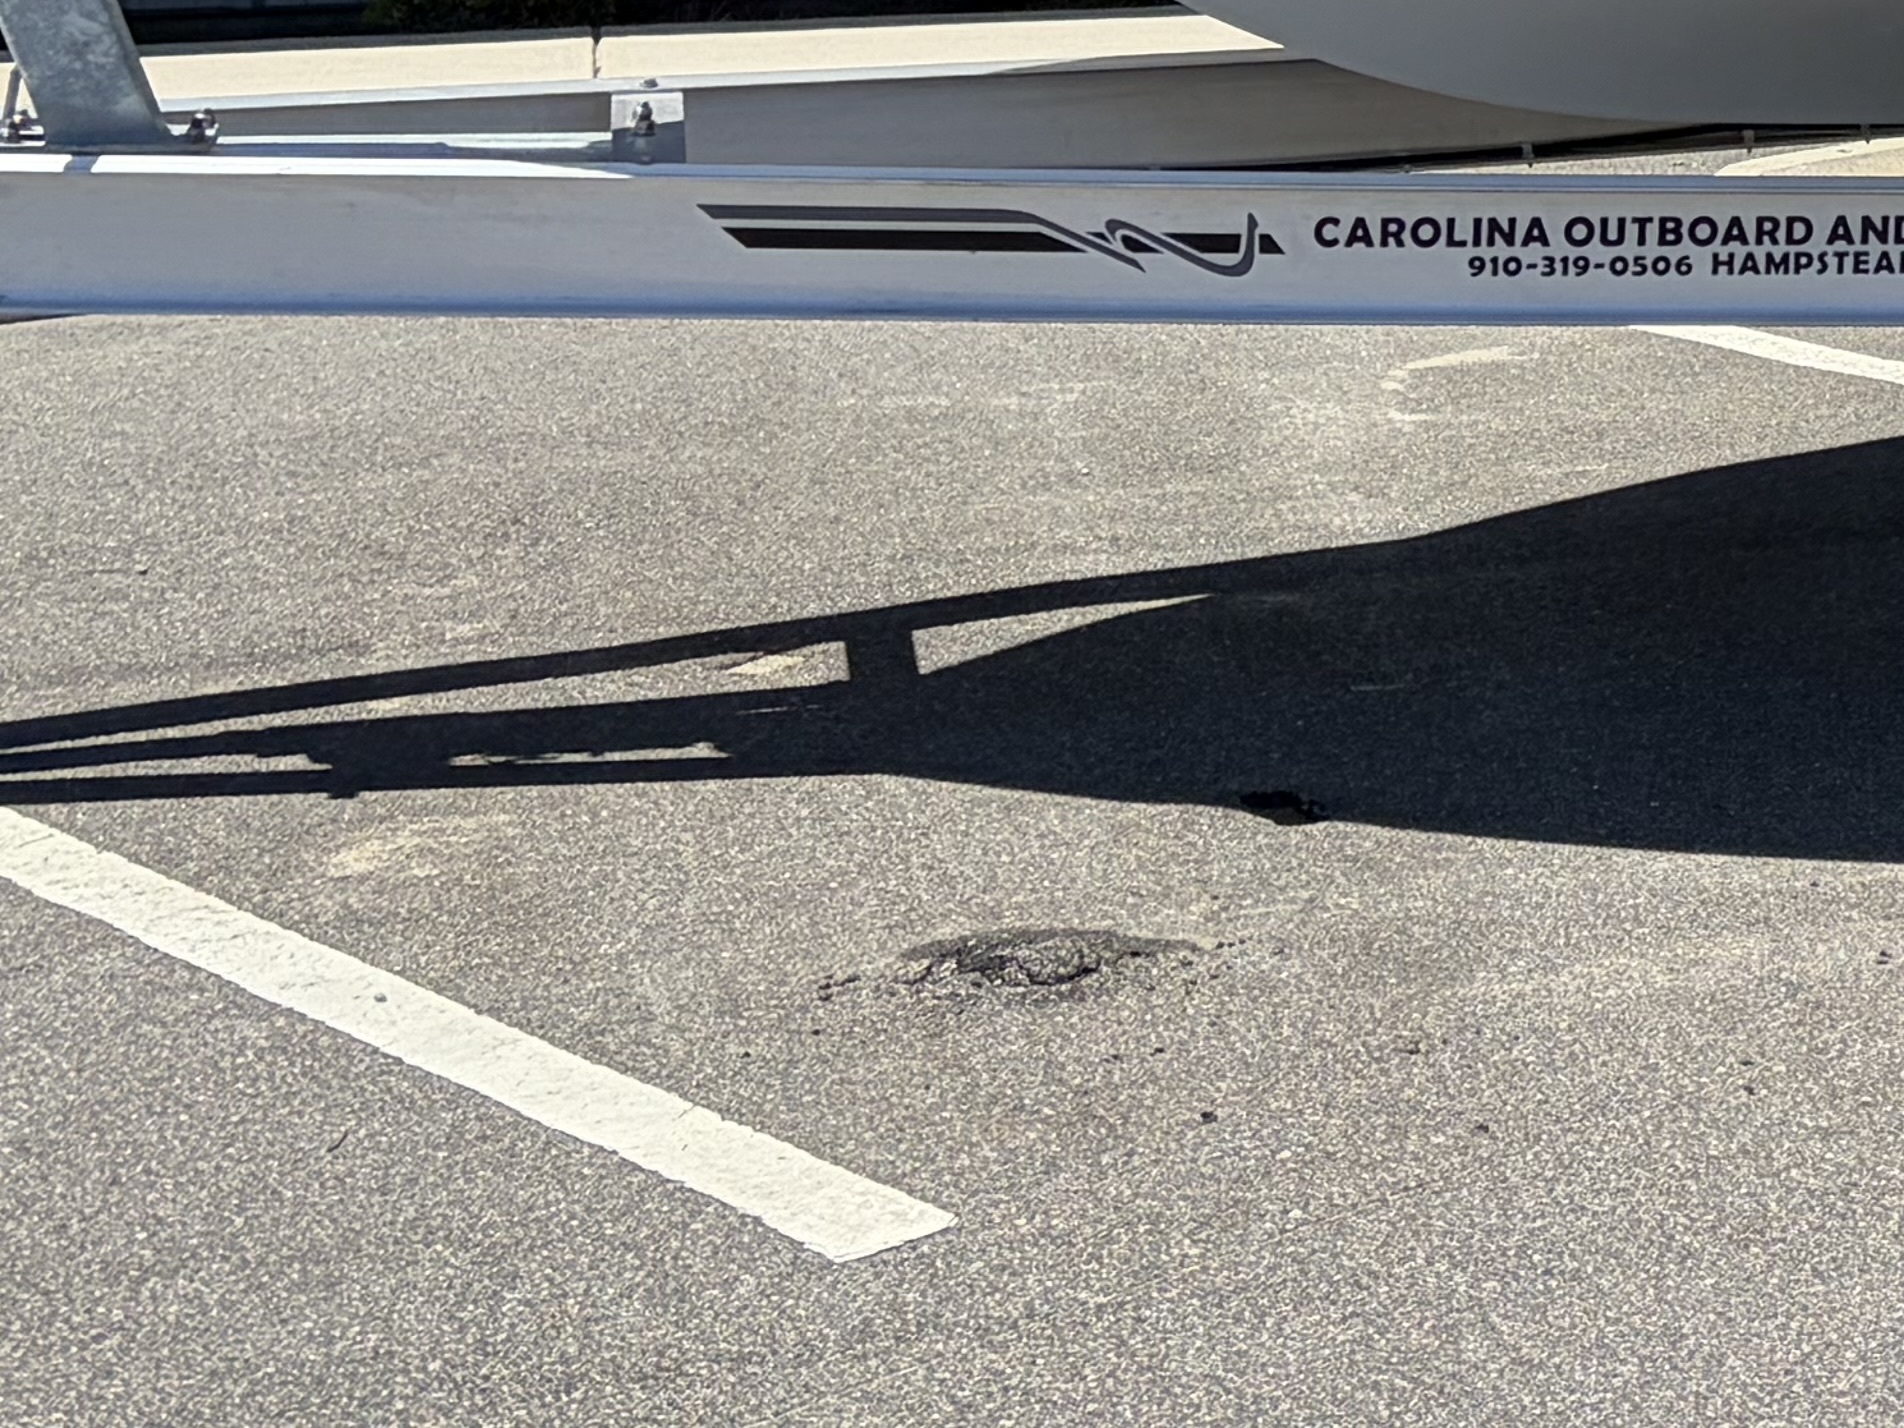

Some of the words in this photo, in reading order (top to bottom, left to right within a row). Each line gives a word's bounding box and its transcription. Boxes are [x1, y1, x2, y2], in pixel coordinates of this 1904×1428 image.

[1313, 216, 1551, 248] CAROLINA
[1563, 215, 1814, 247] OUTBOARD
[1467, 254, 1694, 278] 910-319-0506
